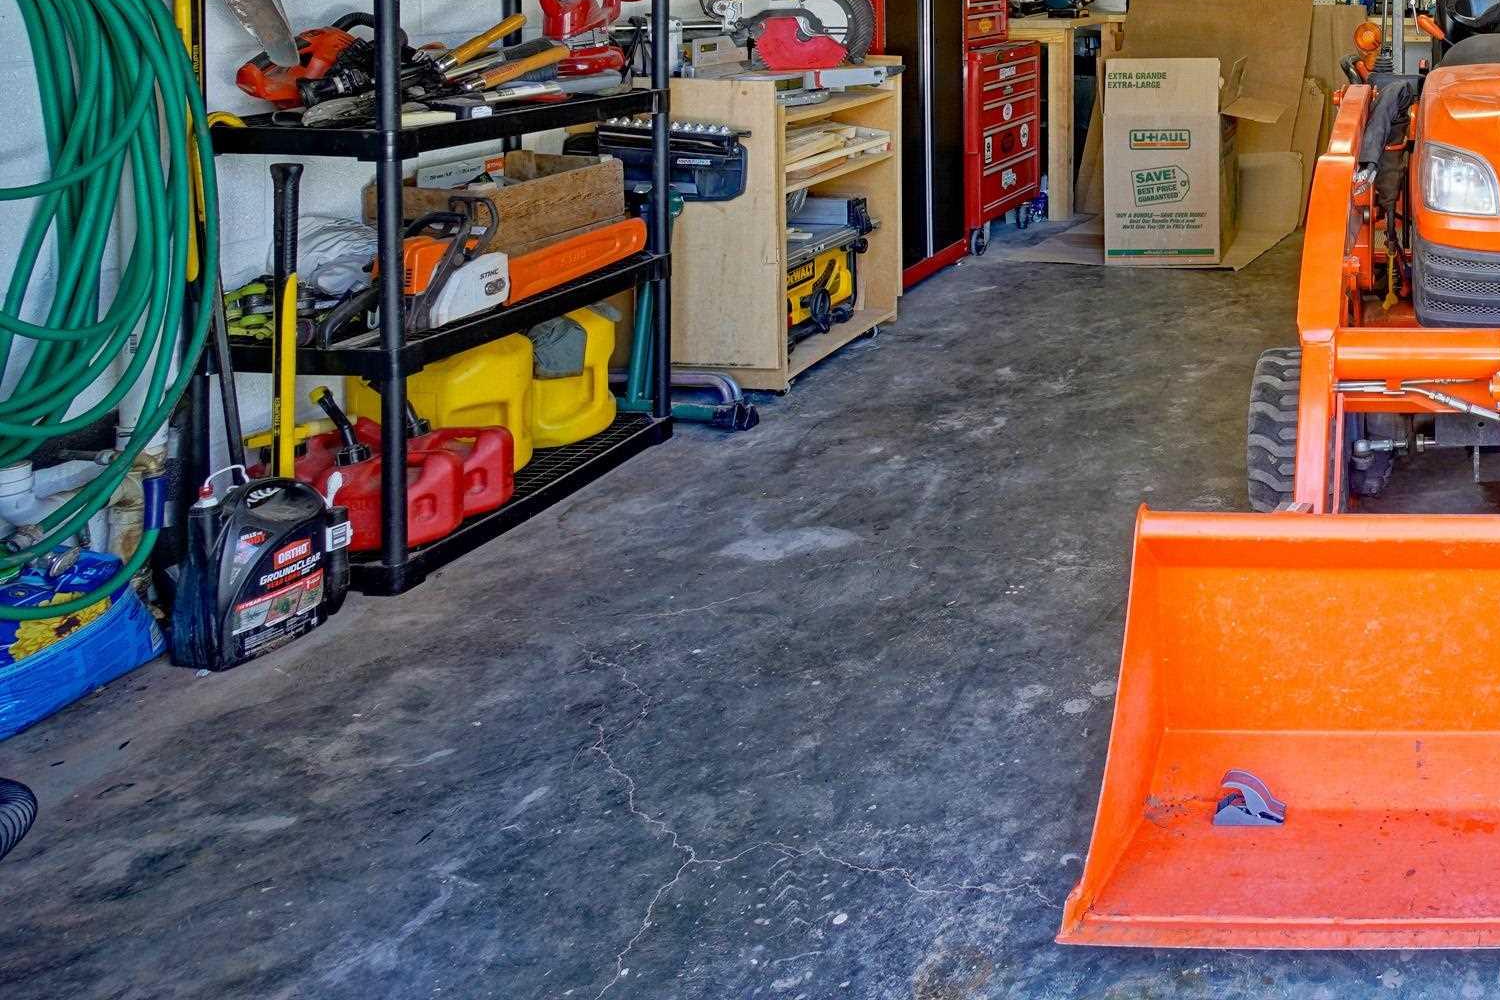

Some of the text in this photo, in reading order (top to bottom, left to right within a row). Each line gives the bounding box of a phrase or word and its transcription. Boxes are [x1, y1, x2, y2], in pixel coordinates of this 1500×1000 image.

[1108, 72, 1167, 80] EXTRA GRANDE
[1108, 81, 1161, 89] EXTRA-LARGE
[1136, 168, 1177, 184] SAVE!
[1137, 183, 1177, 196] BEST PRICE
[278, 543, 309, 564] ORTHO
